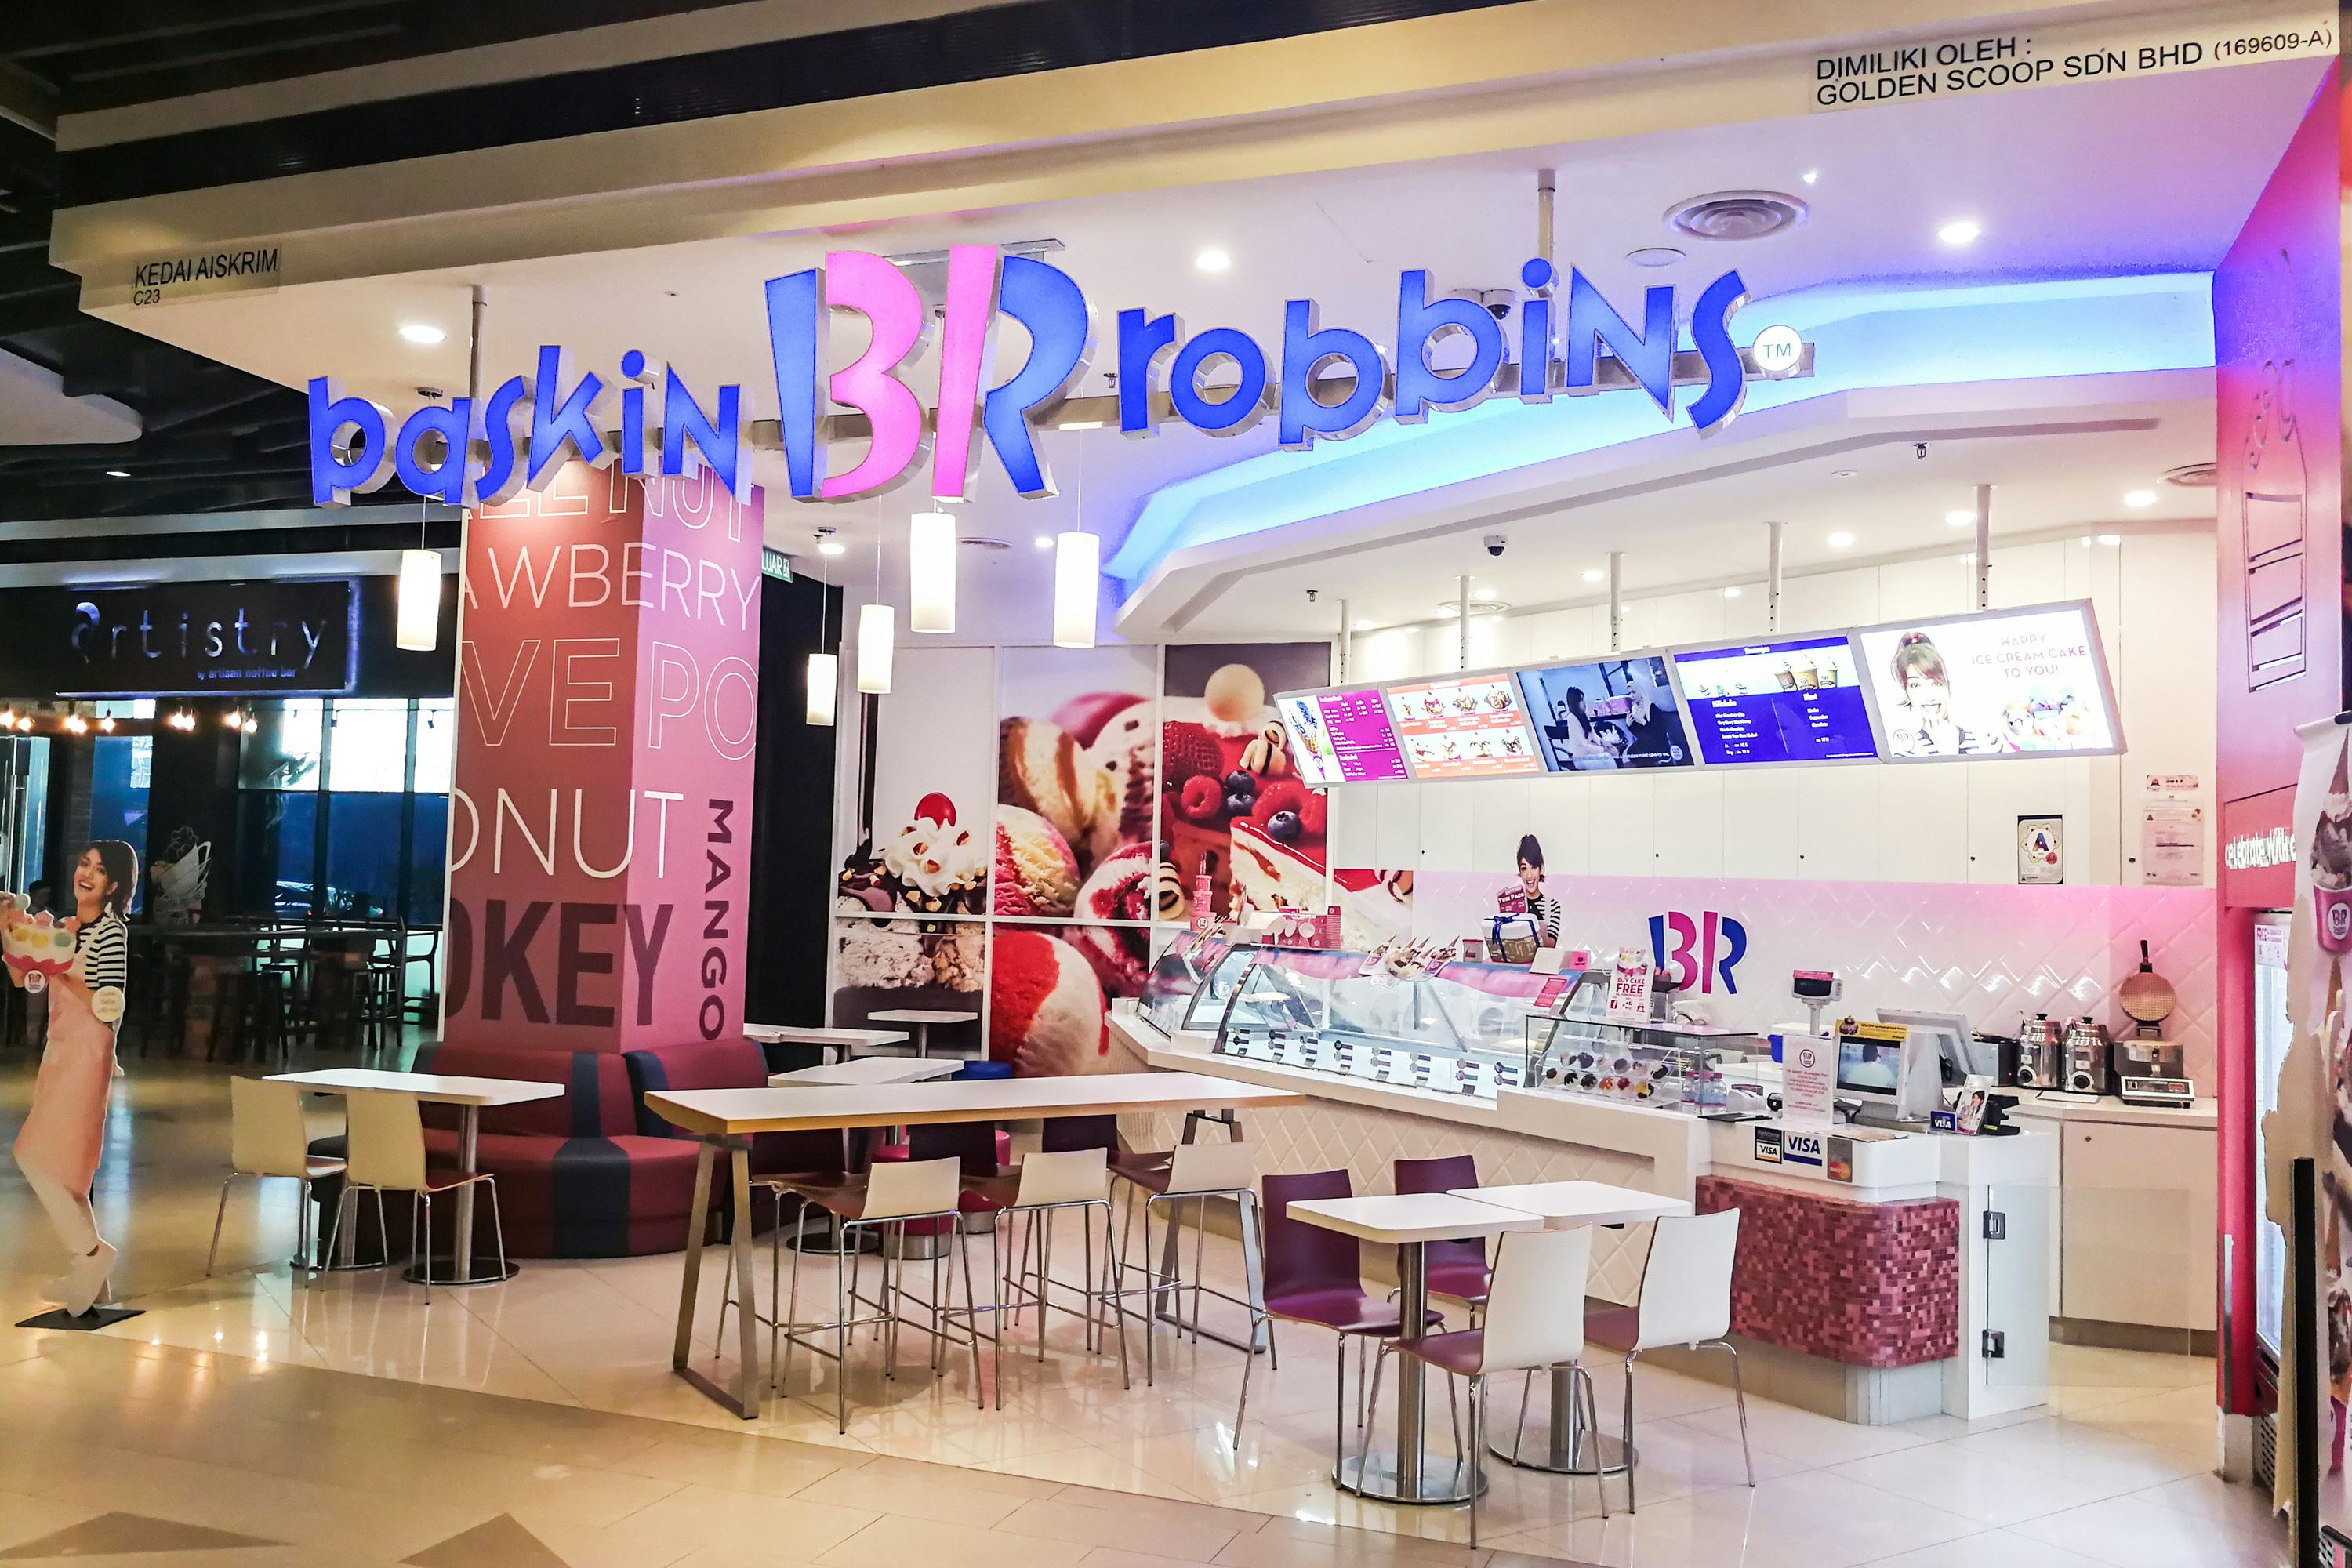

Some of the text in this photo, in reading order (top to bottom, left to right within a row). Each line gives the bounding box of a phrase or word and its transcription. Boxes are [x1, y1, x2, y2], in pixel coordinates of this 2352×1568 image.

[1816, 47, 1926, 81] DIMILIKI
[1936, 37, 2016, 67] OLEH
[1817, 28, 2333, 106] GOLDEN SCOOP SDN BHD (169609-A)
[135, 248, 278, 288] KEDAI AISKRIM
[133, 289, 161, 306] C23
[764, 245, 1088, 502] BR
[1762, 343, 1791, 358] TM
[2001, 633, 2045, 646] HAPPY
[1972, 645, 2086, 665] ICE CREAM CAKE
[281, 666, 296, 677] bar
[2003, 664, 2060, 678] TO YOU!
[699, 798, 735, 1041] MANGO
[1648, 911, 1748, 995] BR
[1617, 983, 1644, 994] FREE
[1759, 1145, 1778, 1156] VISA
[1787, 1134, 1820, 1155] VISA
